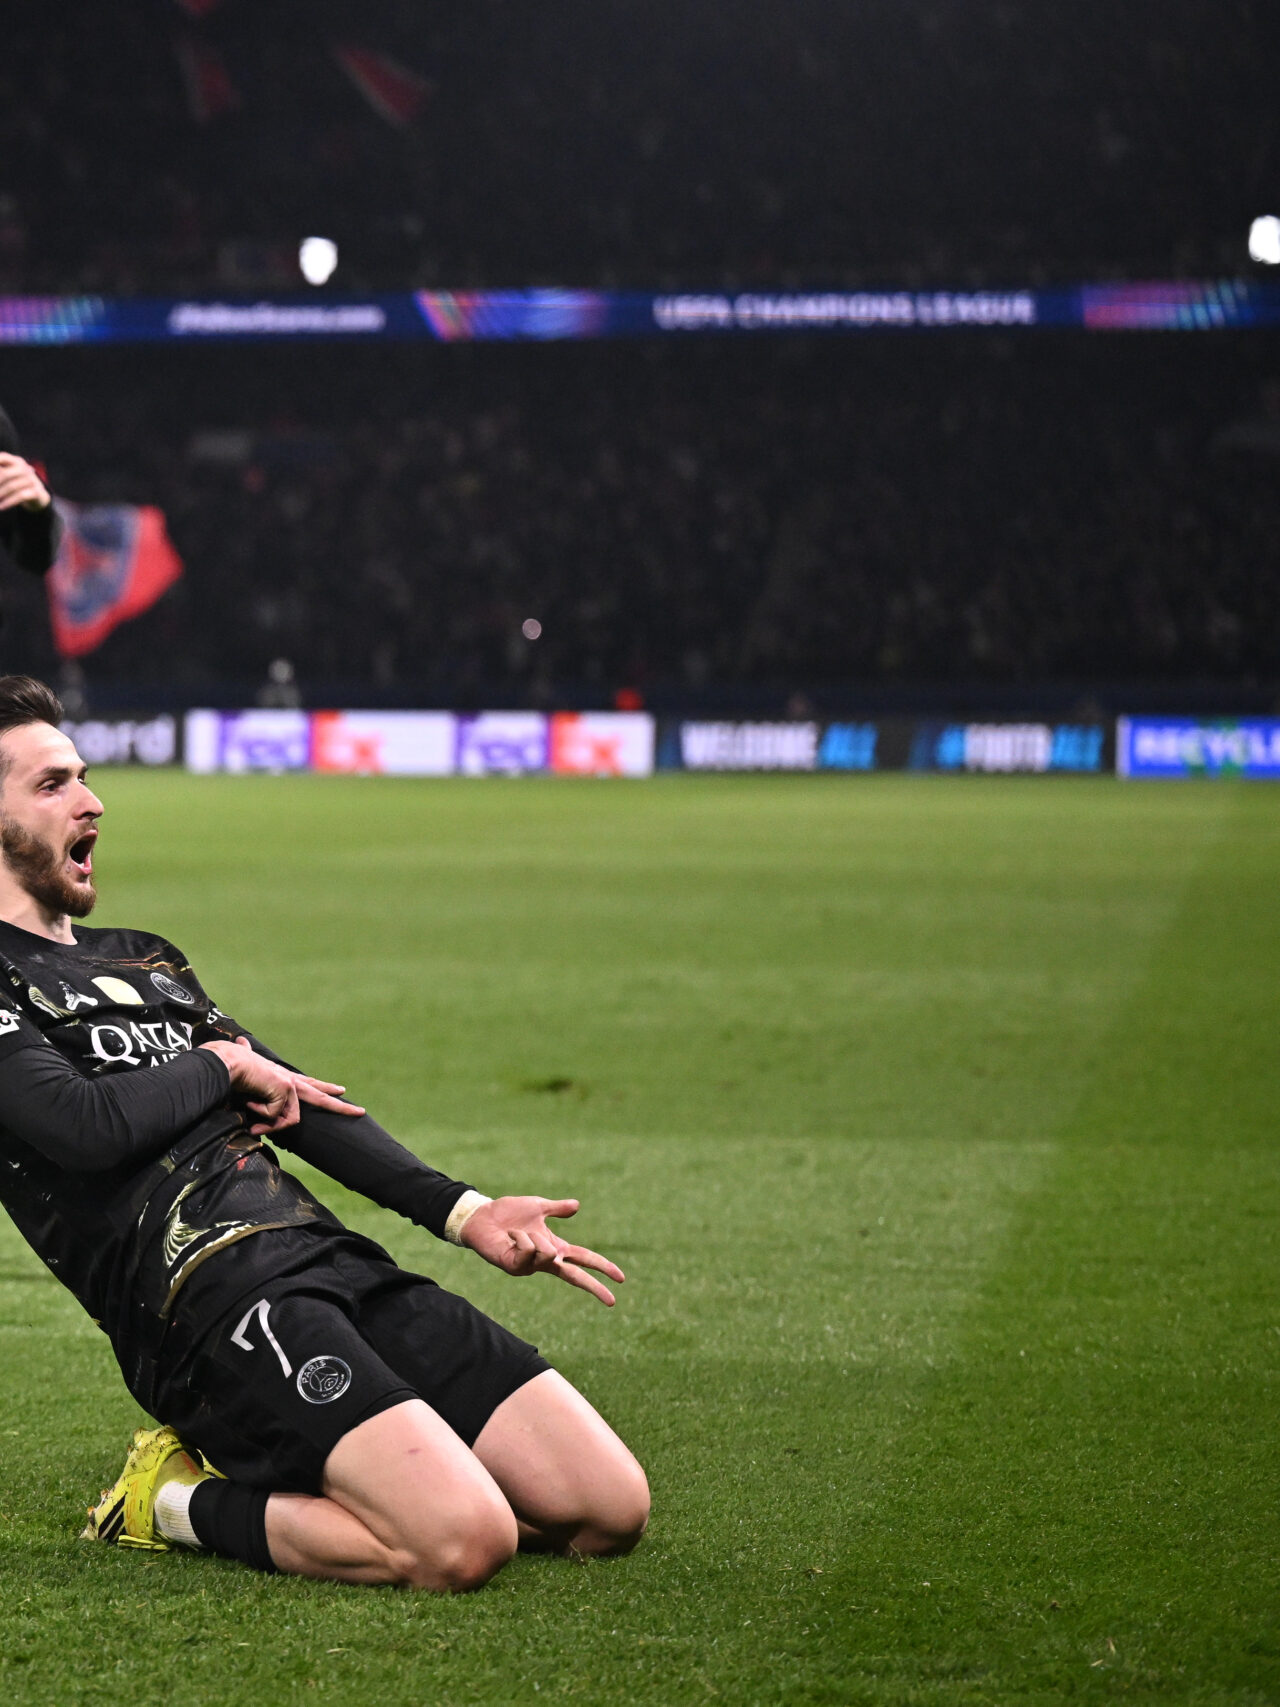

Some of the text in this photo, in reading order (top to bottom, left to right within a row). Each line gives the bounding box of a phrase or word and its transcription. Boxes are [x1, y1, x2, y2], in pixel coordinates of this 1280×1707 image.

[654, 292, 1035, 329] UEFA CHAMPIONS LEAGUE
[230, 1298, 293, 1379] 7
[301, 1360, 327, 1384] PARIS
